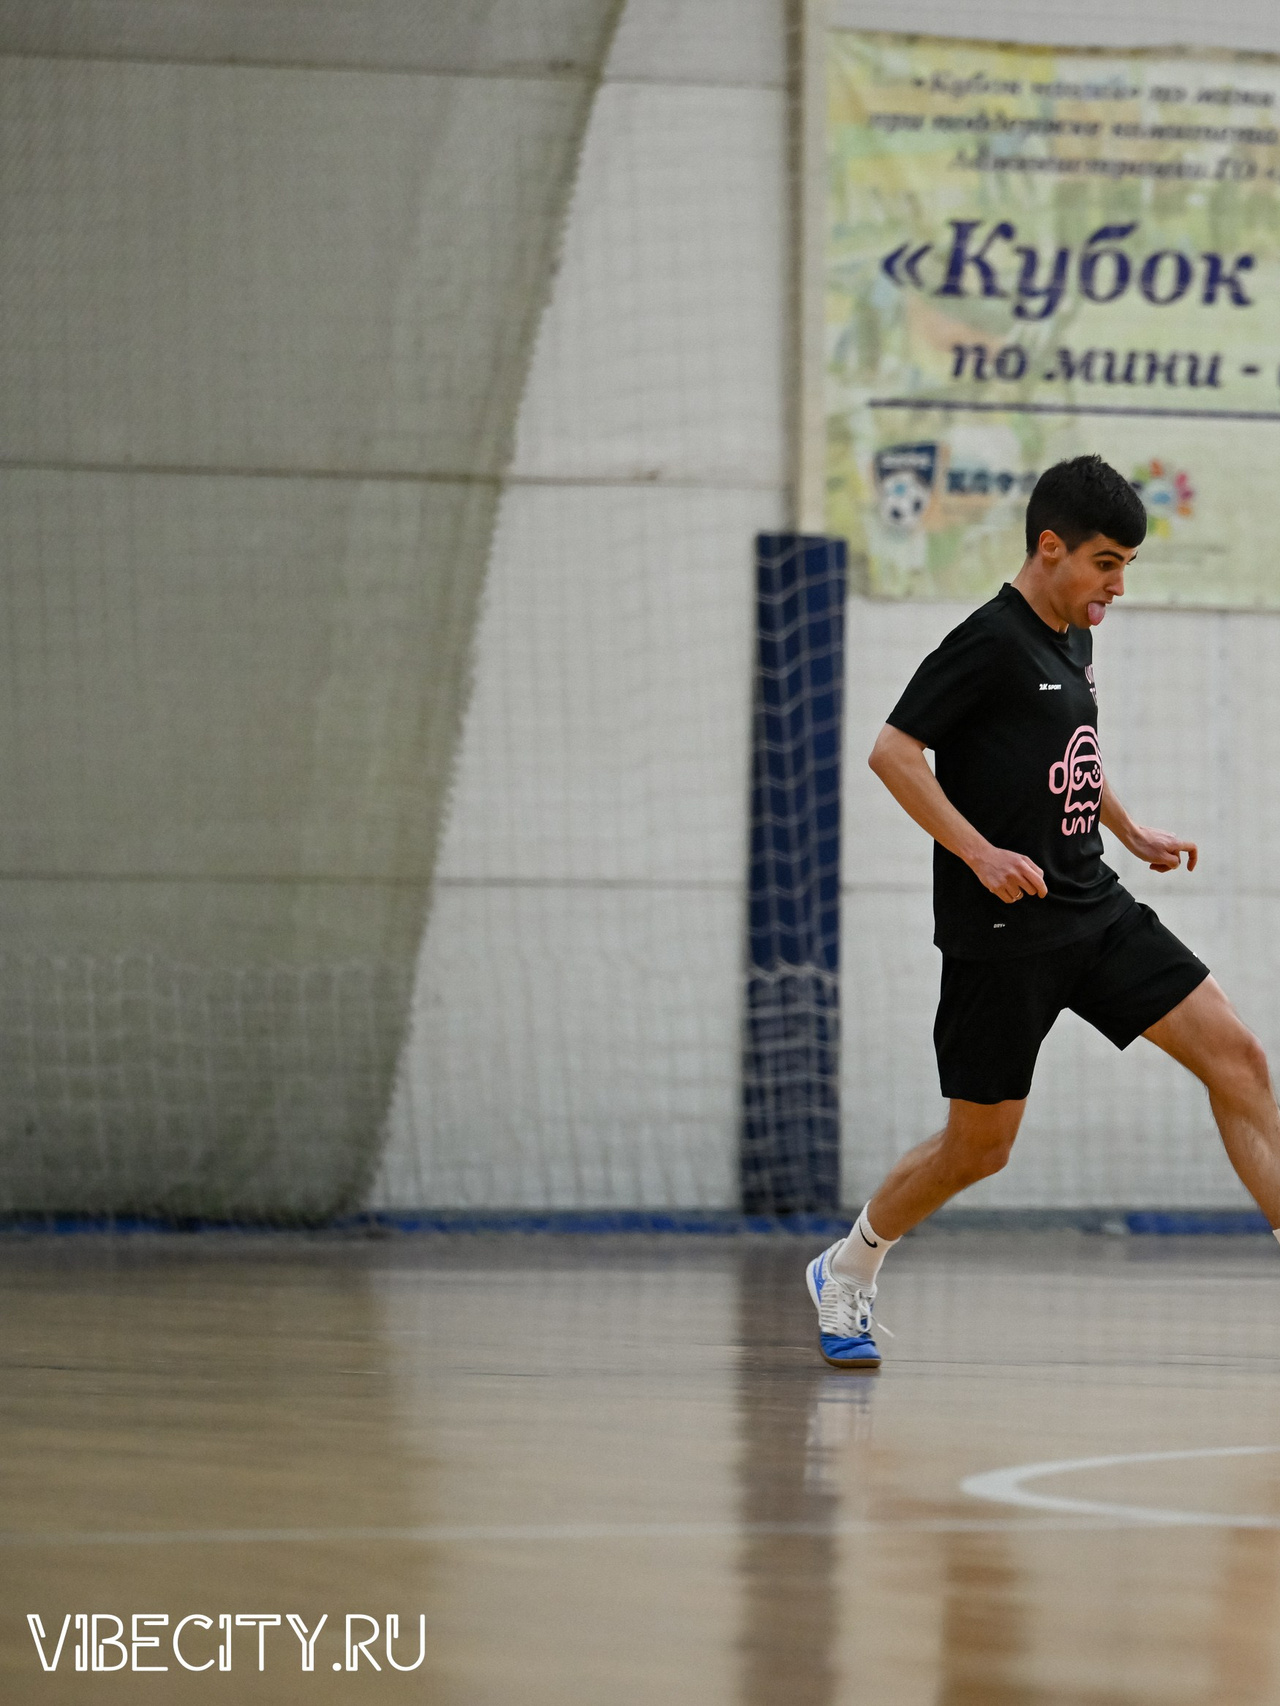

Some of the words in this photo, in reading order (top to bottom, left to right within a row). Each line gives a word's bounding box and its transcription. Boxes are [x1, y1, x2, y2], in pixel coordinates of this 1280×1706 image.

[880, 220, 1257, 321] «Кубок
[952, 343, 1029, 382] по
[1042, 346, 1222, 388] мини
